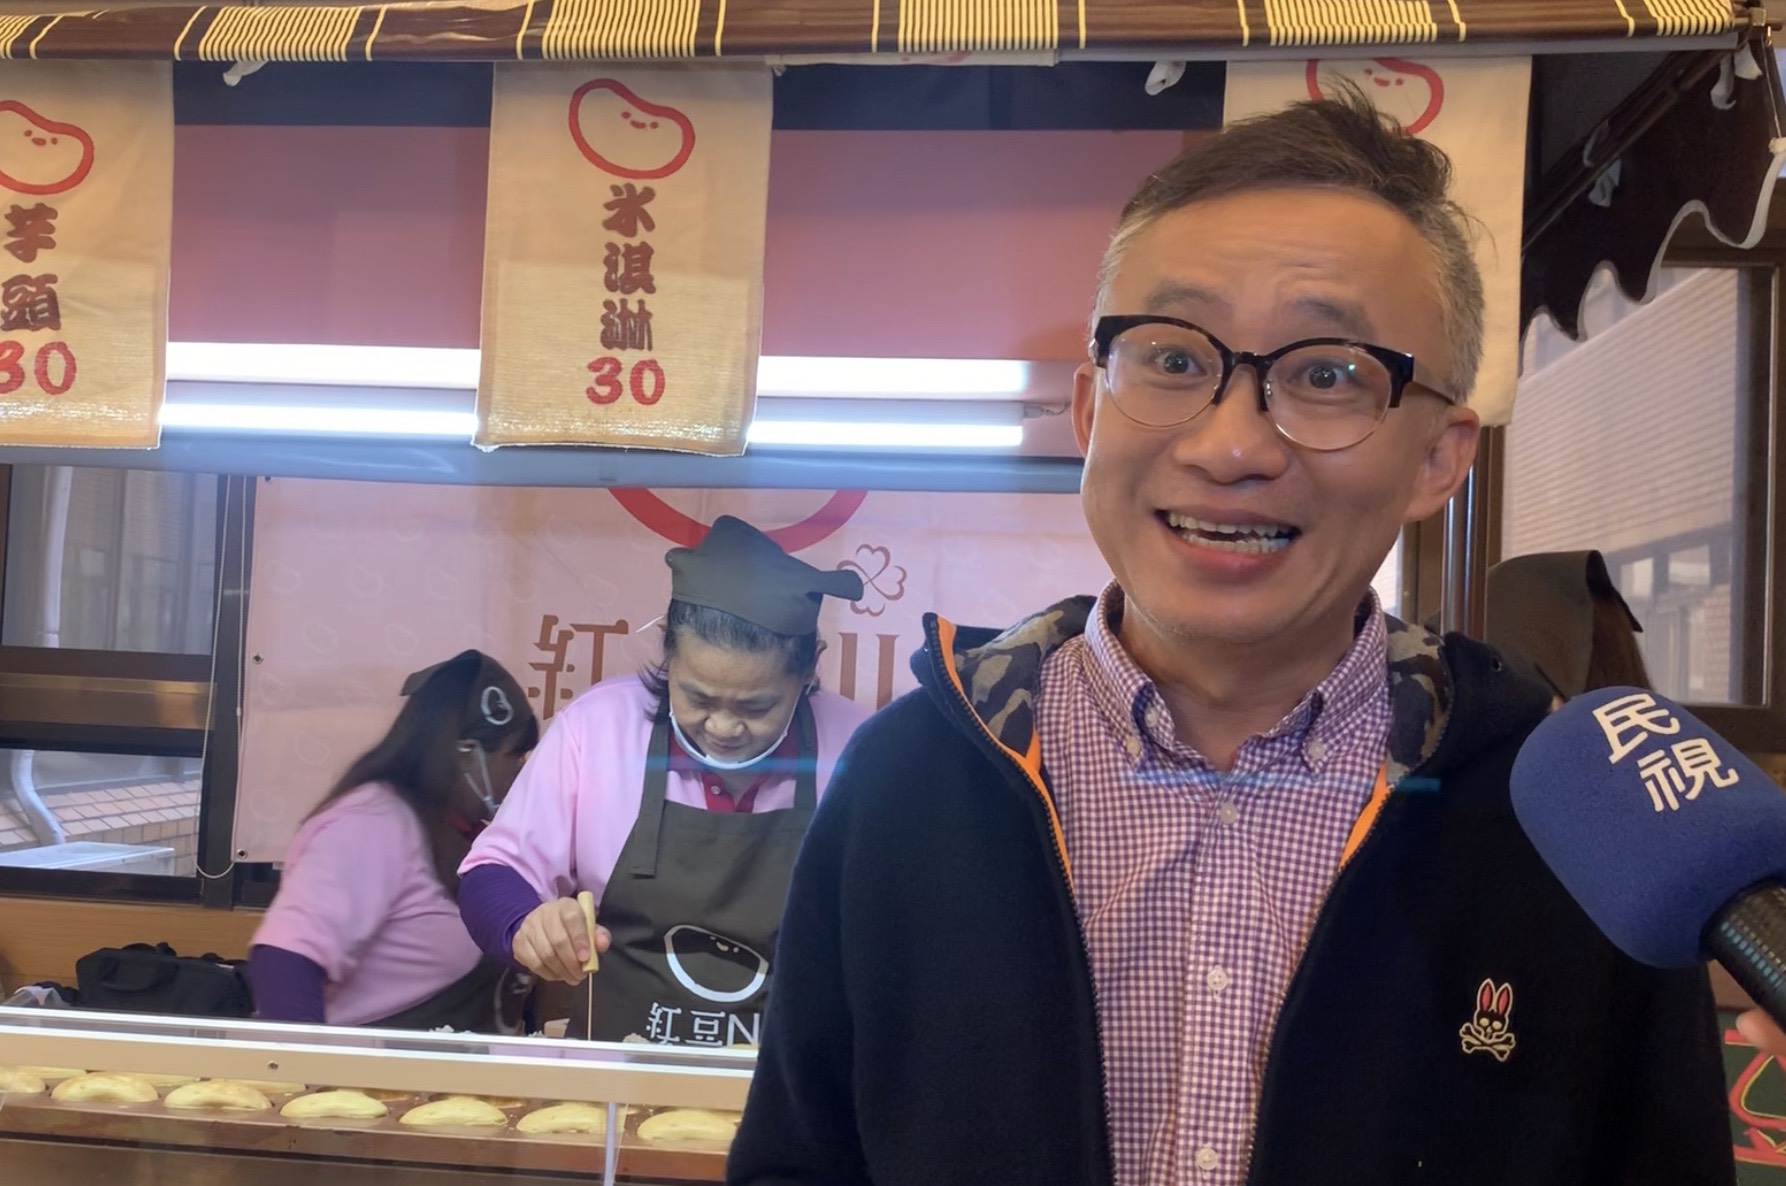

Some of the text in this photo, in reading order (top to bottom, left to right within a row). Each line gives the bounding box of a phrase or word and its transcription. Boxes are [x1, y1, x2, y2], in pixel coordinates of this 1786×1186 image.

[1, 203, 61, 331] 芋頭
[586, 357, 665, 405] 30
[1592, 693, 1739, 812] 民視
